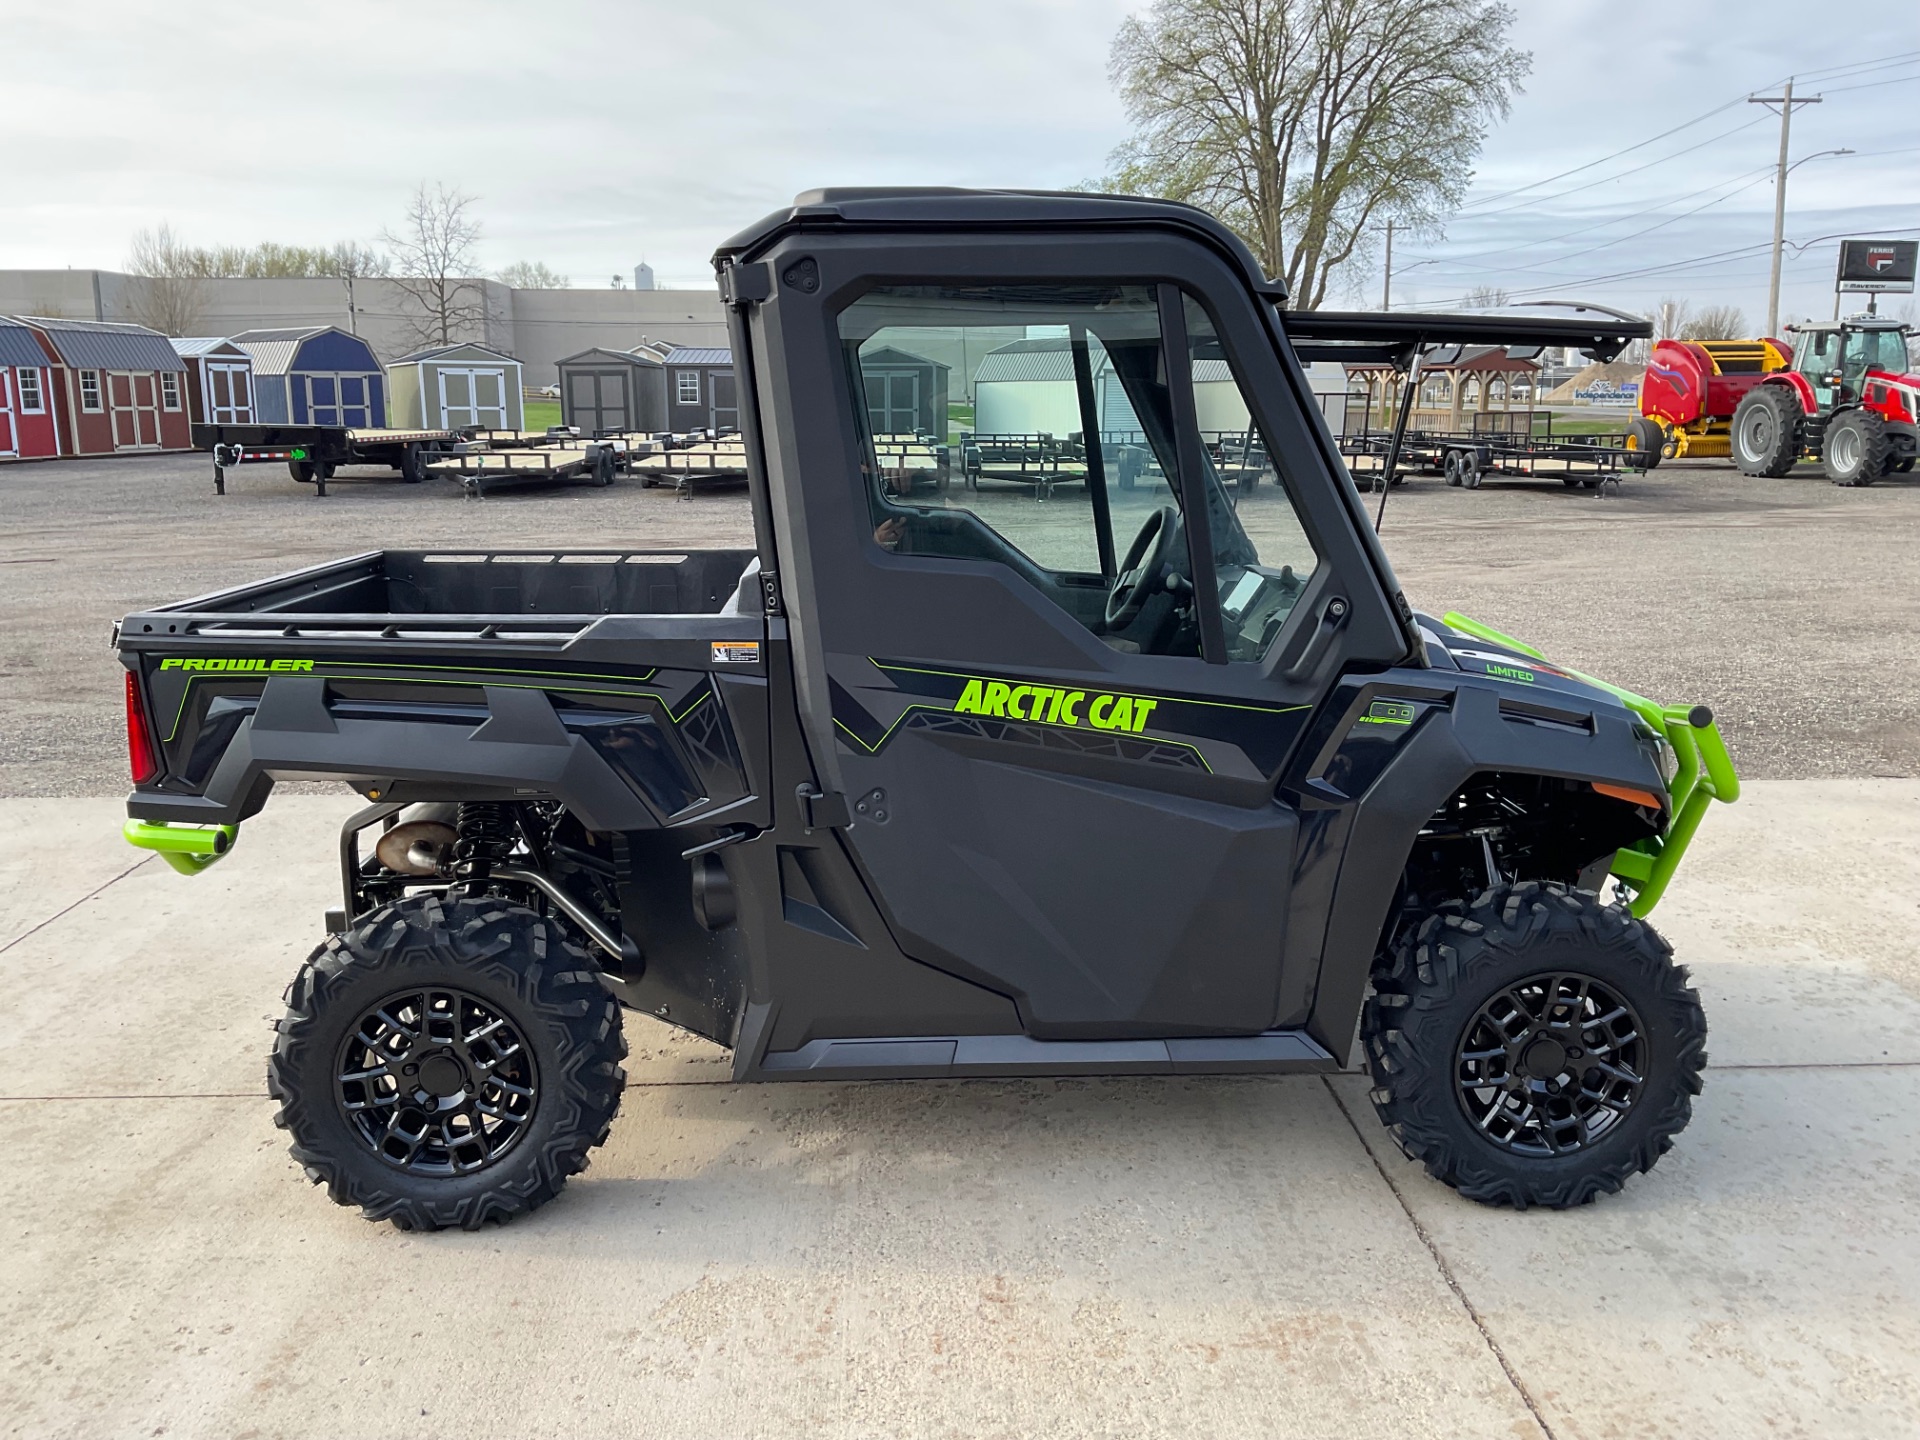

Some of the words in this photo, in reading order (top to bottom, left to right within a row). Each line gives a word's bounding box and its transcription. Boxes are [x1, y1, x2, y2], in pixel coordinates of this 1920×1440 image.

[1575, 388, 1635, 403] Independence
[160, 658, 315, 671] PROWLER
[1486, 664, 1534, 682] LIMITED
[953, 679, 1085, 726] ARCTIC
[1088, 695, 1157, 732] CAT
